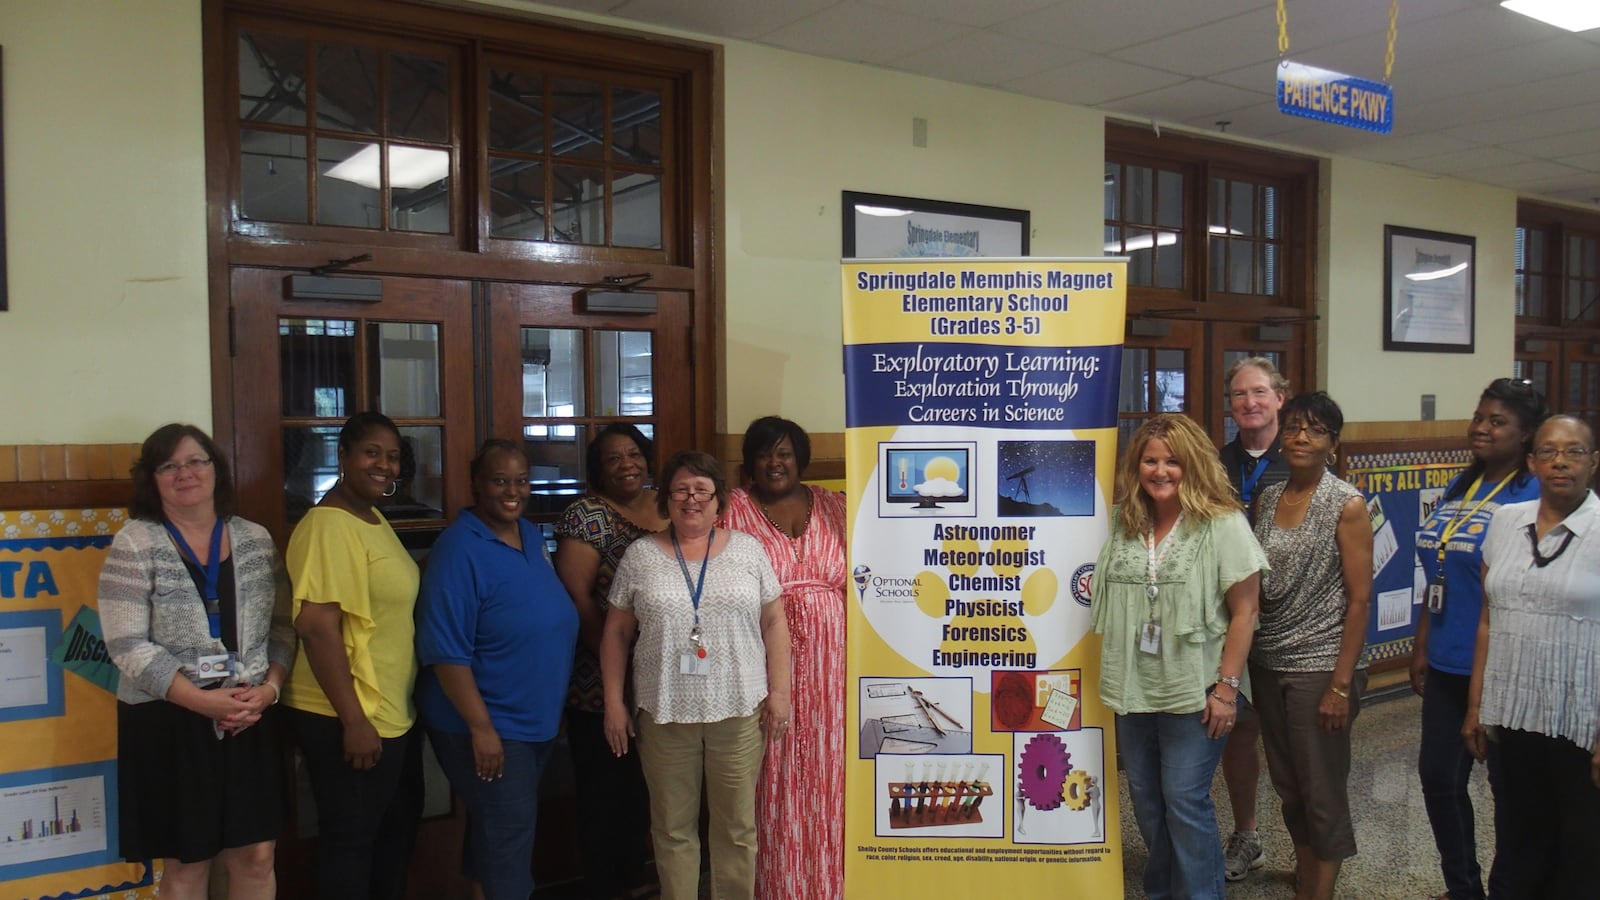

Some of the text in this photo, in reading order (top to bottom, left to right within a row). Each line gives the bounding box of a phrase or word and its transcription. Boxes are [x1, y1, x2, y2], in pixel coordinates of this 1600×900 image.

[1284, 75, 1387, 124] PATIENCE PKWY
[907, 219, 979, 253] Springdale Elementary
[857, 270, 1113, 292] Springdale Memphis Magnet
[902, 293, 1069, 314] Elementary School
[930, 316, 1041, 336] (Grades 3-5)
[872, 345, 1100, 379] Exploratory Learning:
[894, 373, 1078, 403] Exploration Through
[908, 402, 1064, 422] Careers in Science
[1368, 473, 1393, 494] IT'S
[1397, 471, 1421, 491] ALL
[933, 523, 1036, 541] Astronomer
[924, 549, 1046, 567] Meteorologist
[949, 574, 1021, 592] Chemist
[945, 599, 1025, 617] Physicist
[942, 624, 1027, 642] Forensics
[932, 649, 1037, 668] Engineering
[857, 845, 877, 853] Shelby
